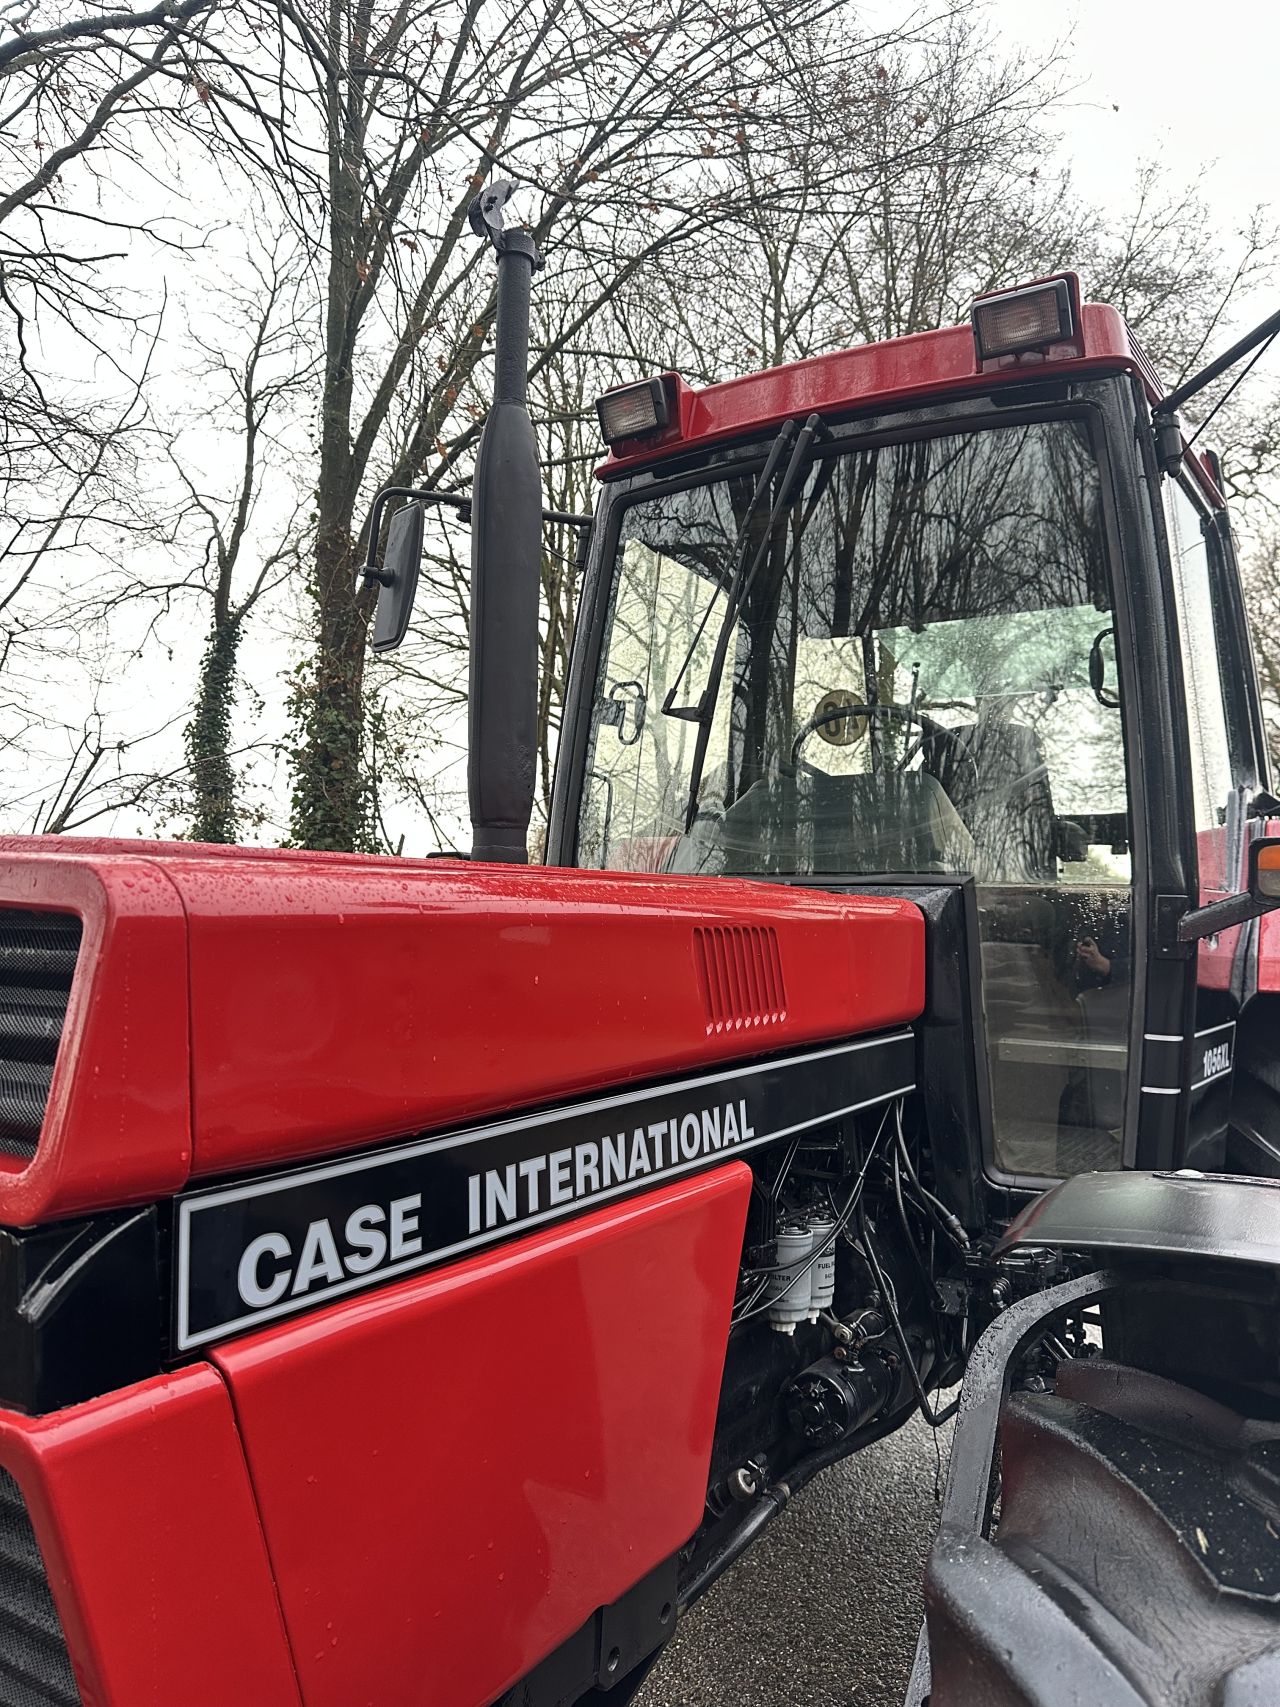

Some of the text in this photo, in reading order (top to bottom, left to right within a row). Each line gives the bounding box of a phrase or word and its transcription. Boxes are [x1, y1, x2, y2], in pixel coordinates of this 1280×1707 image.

[1203, 1042, 1229, 1078] 1056XL
[237, 1099, 755, 1308] CASE INTERNATIONAL
